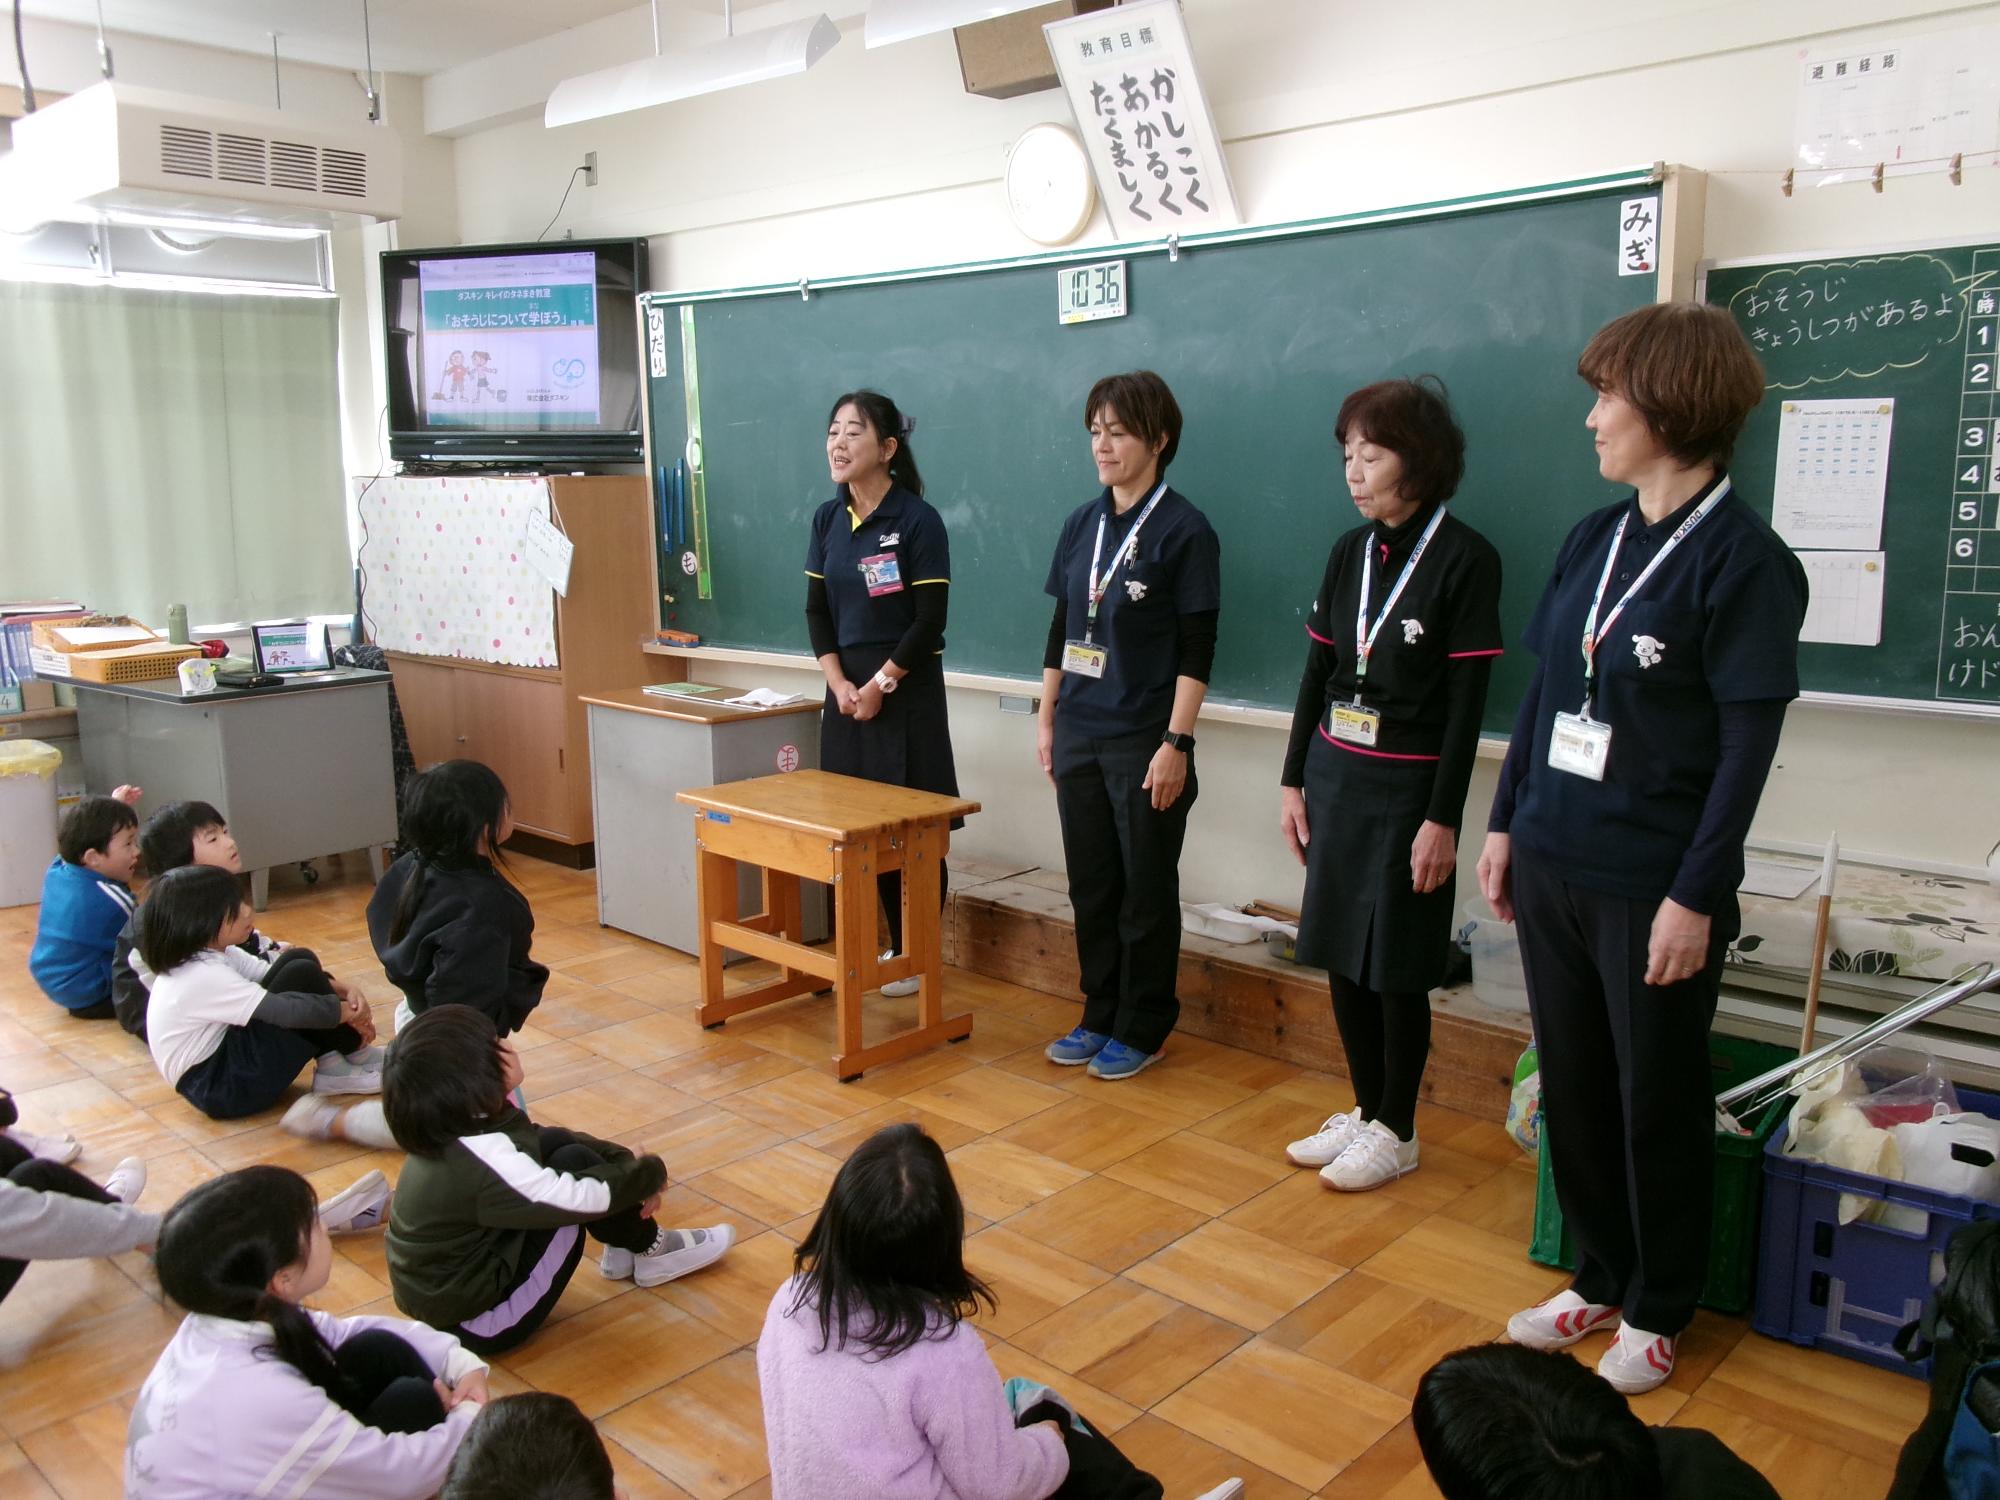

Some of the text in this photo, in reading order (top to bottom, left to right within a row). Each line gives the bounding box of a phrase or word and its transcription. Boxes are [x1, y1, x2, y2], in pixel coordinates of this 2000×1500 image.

[1080, 27, 1155, 58] 教育目標
[1812, 54, 1896, 80] 避難経路
[1089, 80, 1153, 222] たくましく
[1119, 72, 1183, 215] あかるく
[1149, 67, 1209, 213] かしこく
[1623, 203, 1653, 271] みぎ
[1746, 277, 1847, 319] おそうじ
[1752, 293, 1954, 352] きょうしつがあるよ
[1977, 325, 1990, 346] 1
[651, 314, 665, 376] ひだり
[1970, 363, 1990, 384] 2
[1964, 427, 1984, 447] 3
[1960, 464, 1981, 484] 4
[1673, 509, 1703, 543] DUSKIN
[1958, 502, 1978, 521] 5
[1955, 538, 1974, 557] 6
